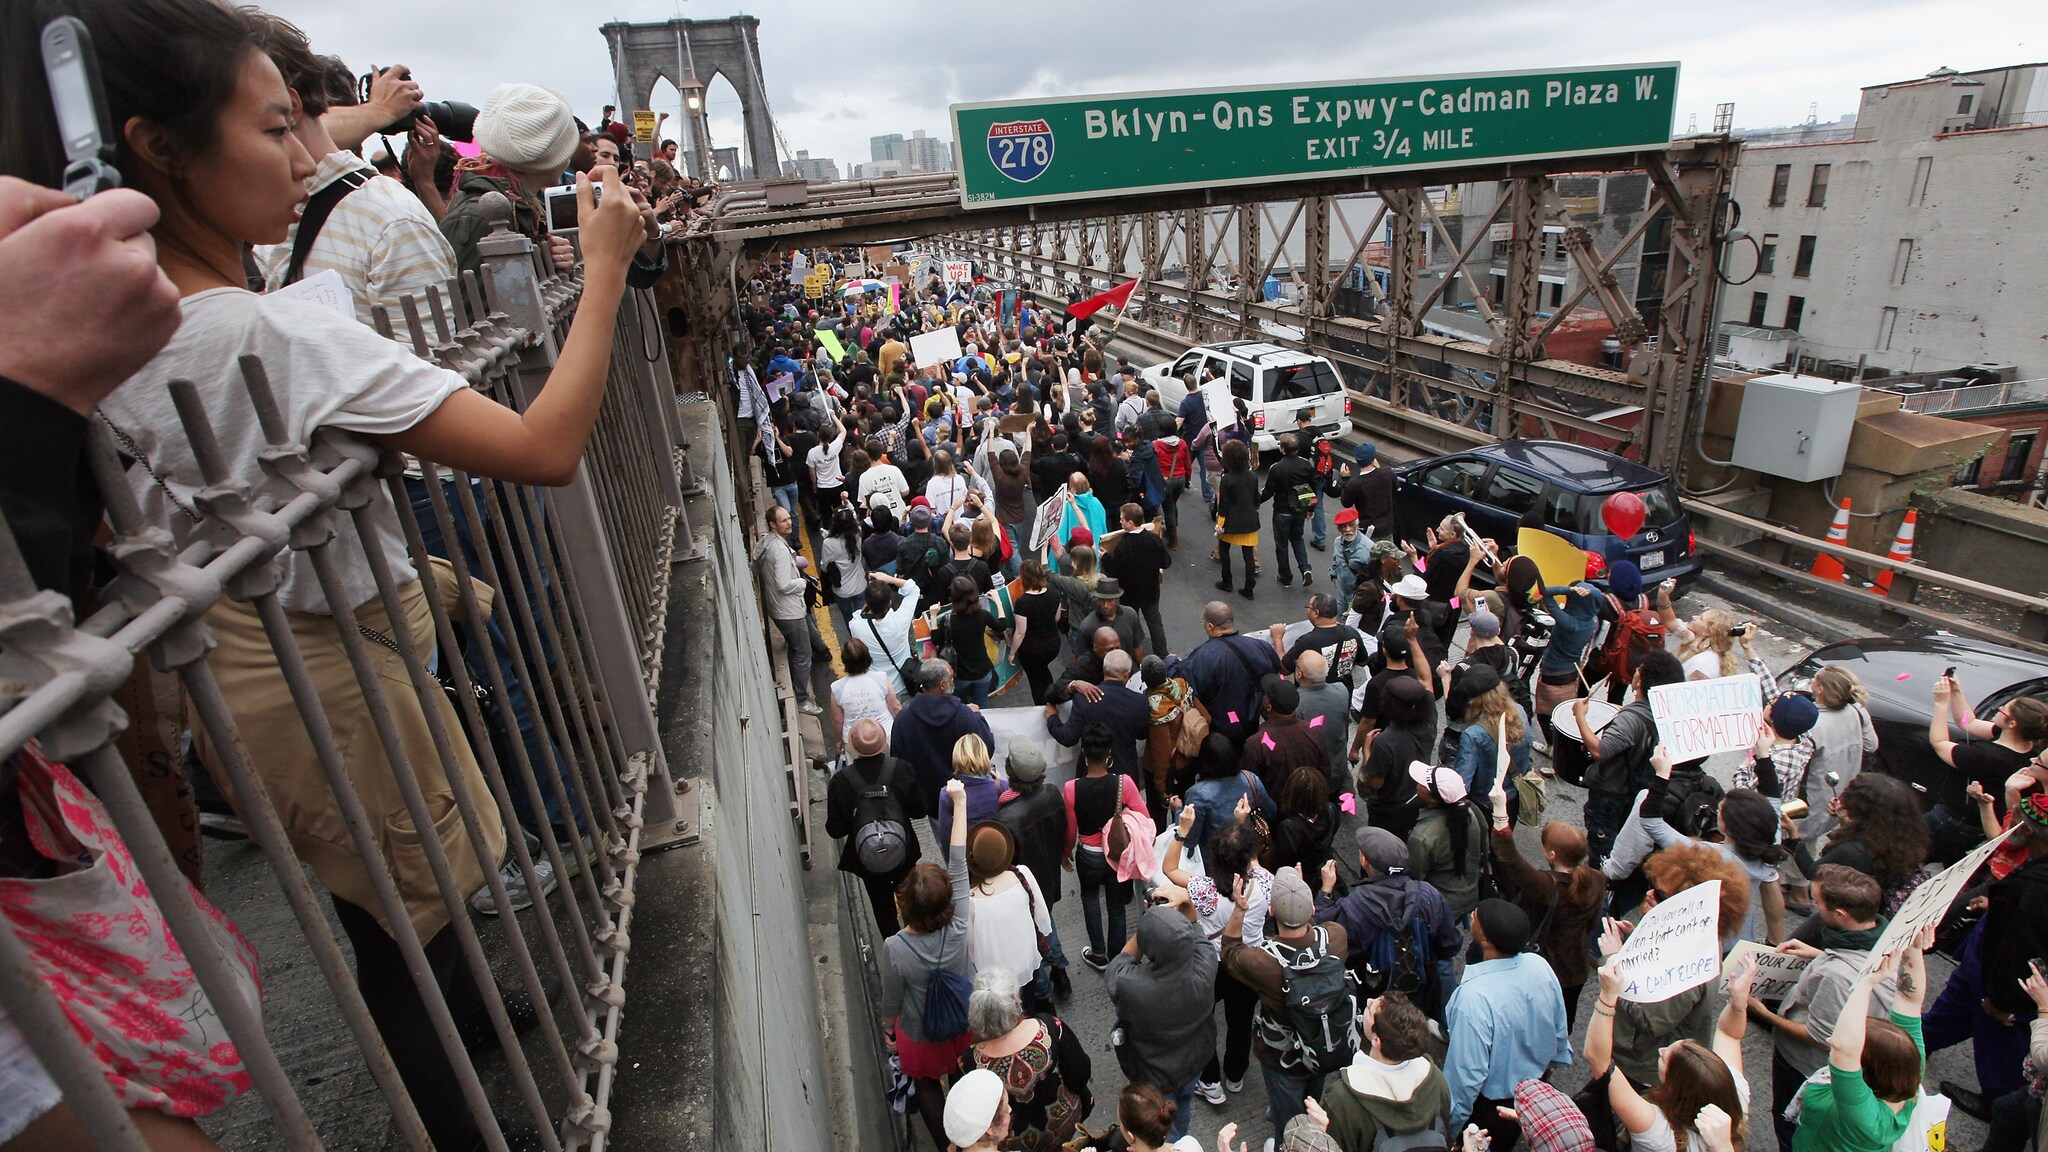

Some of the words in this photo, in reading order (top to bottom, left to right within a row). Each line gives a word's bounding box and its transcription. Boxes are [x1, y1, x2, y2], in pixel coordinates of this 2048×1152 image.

[1086, 105, 1273, 142] Bklyn-Qns
[1292, 86, 1530, 132] Expwy-Cadman
[1546, 80, 1619, 107] Plaza
[1635, 76, 1658, 101] W.
[995, 124, 1043, 135] INTERSTATE
[999, 136, 1049, 169] 278
[1307, 136, 1360, 160] EXIT
[1373, 129, 1411, 159] 3/4
[1423, 128, 1473, 151] MILE
[946, 263, 969, 271] WAKE
[950, 270, 968, 282] UP!
[1653, 682, 1762, 719] INFORMATION
[1657, 711, 1763, 755] INFORMATION!
[1649, 926, 1674, 947] that
[1754, 952, 1786, 969] YOUR
[1785, 957, 1812, 972] LOS
[1624, 980, 1640, 995] A
